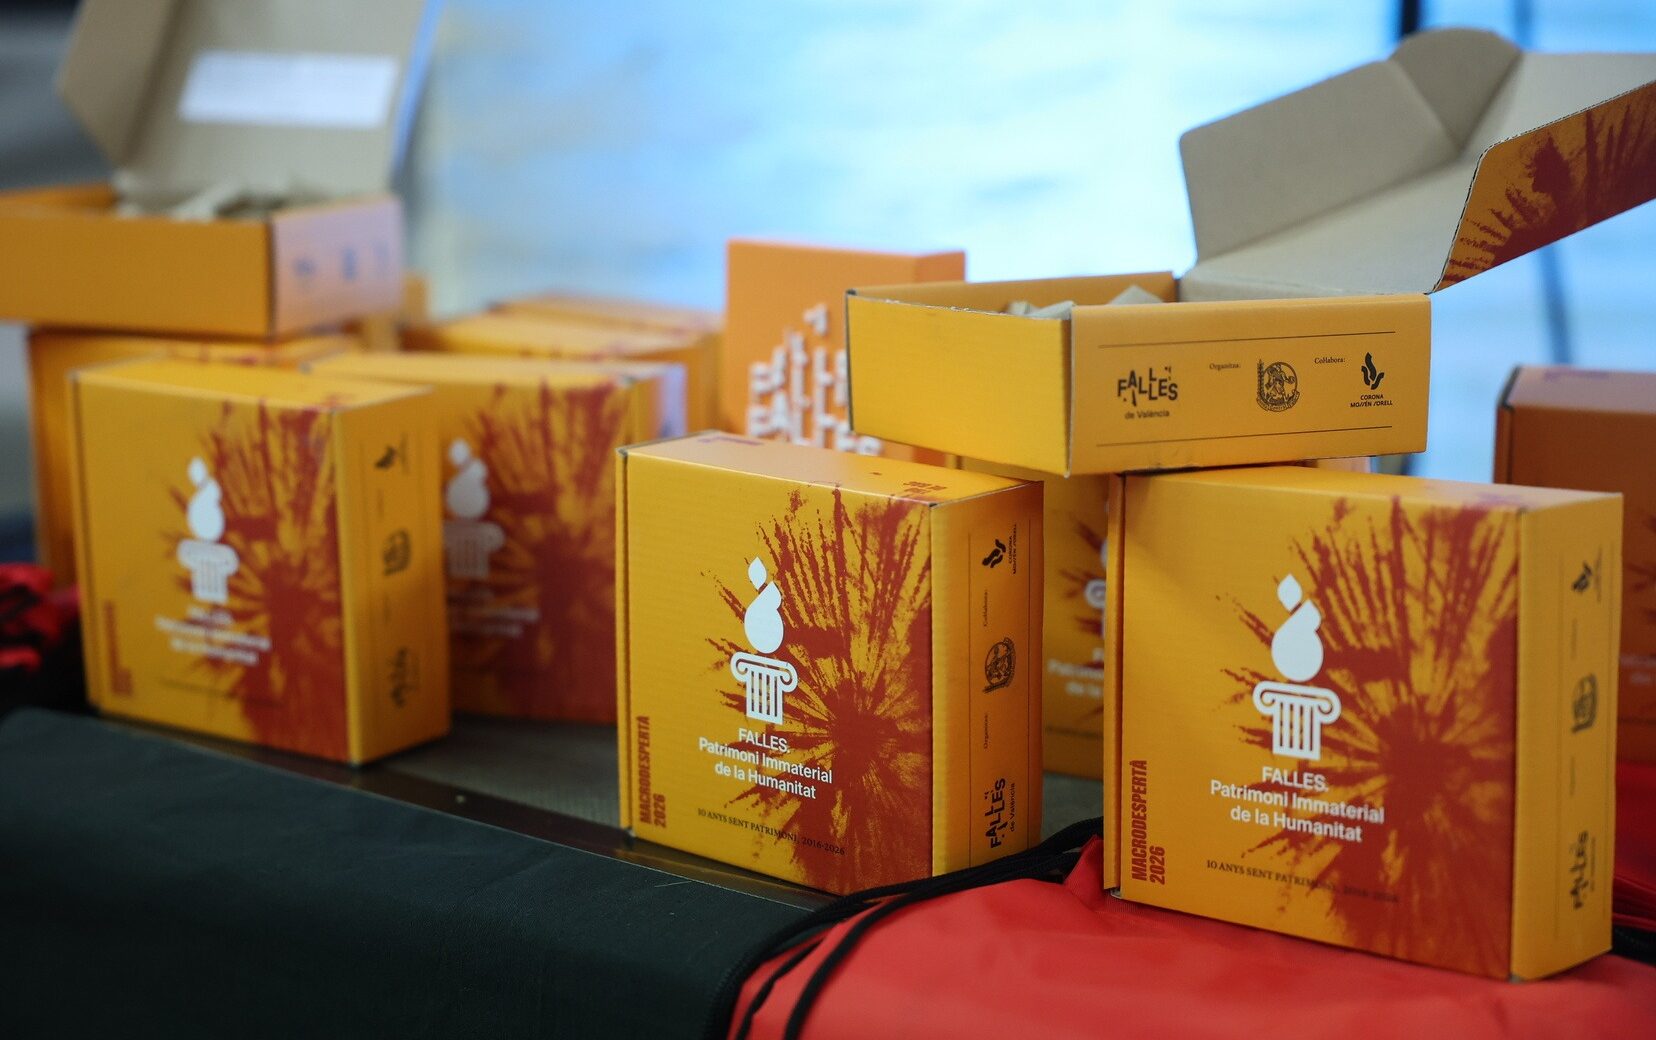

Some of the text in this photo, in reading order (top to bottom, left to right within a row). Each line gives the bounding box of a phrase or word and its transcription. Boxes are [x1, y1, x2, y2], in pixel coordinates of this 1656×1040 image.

[1117, 366, 1178, 407] FALLES
[1125, 411, 1135, 419] de
[739, 728, 790, 753] FALLES.
[699, 737, 833, 784] Patrimoni Immaterial
[715, 761, 816, 799] de la Humanitat
[1261, 766, 1329, 792] FALLES.
[653, 794, 666, 828] 2026
[1210, 780, 1384, 824] Patrimoni Immaterial
[1230, 806, 1362, 842] de la Humanitat
[1149, 846, 1165, 885] 2026
[1219, 862, 1245, 874] ANYS
[1246, 867, 1273, 880] SENT
